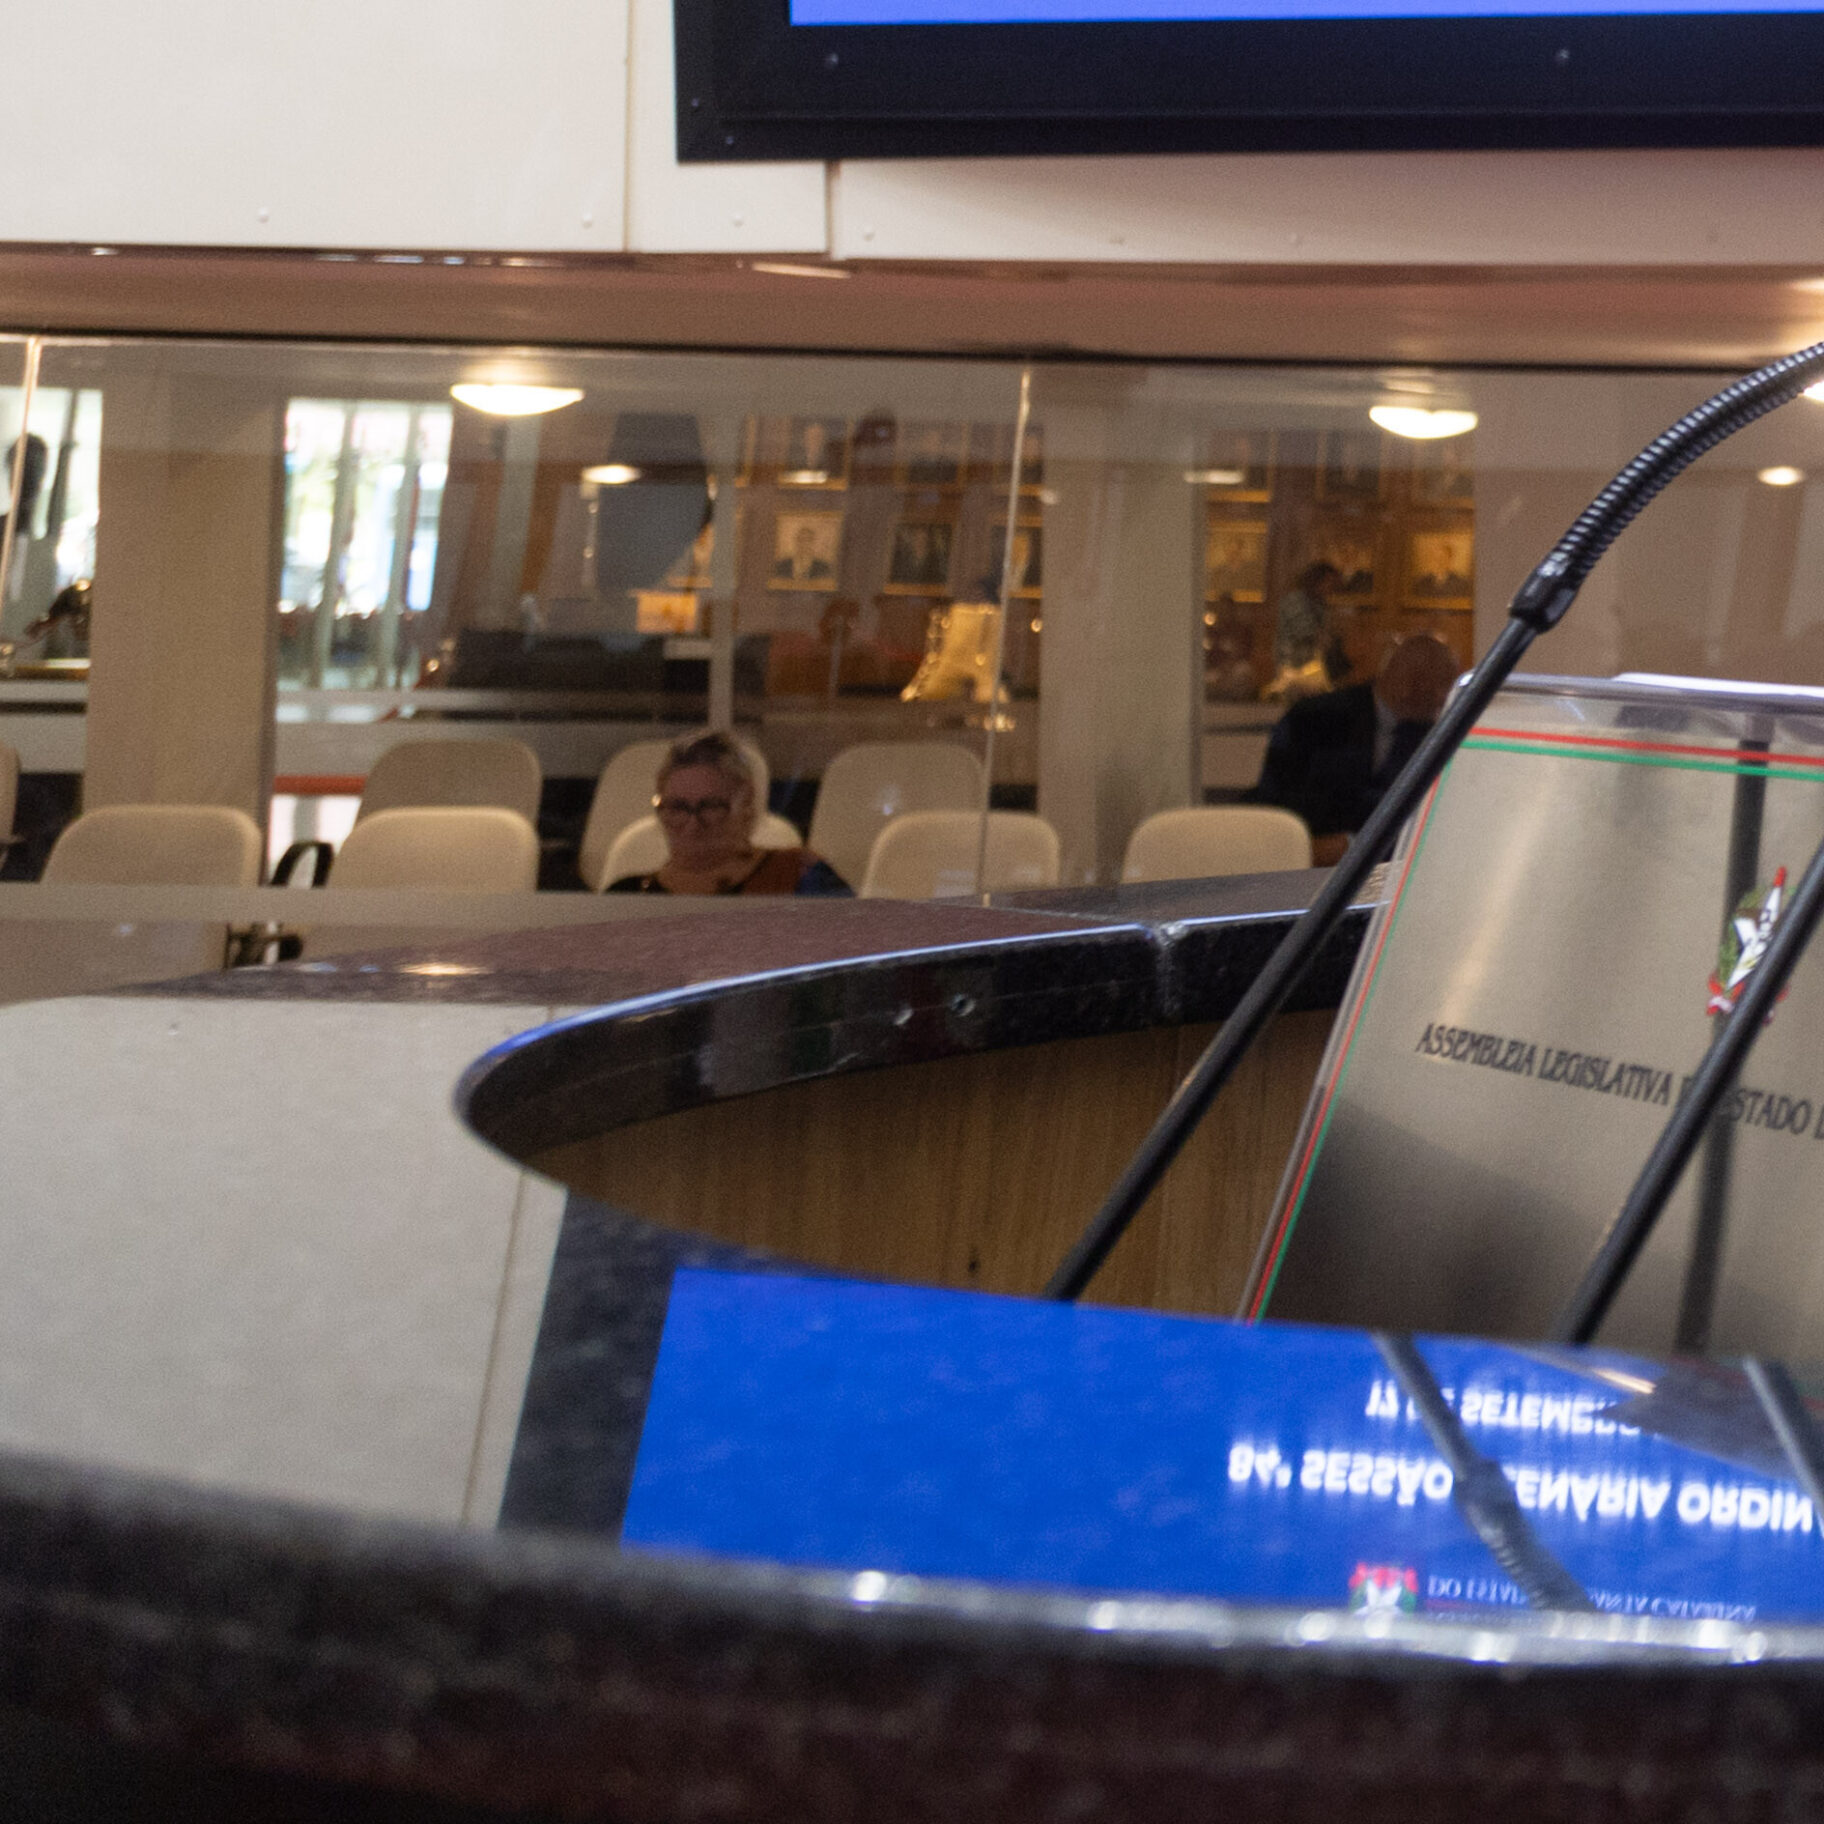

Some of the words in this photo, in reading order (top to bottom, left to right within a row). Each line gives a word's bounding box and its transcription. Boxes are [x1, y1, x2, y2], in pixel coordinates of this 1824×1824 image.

[1415, 1022, 1537, 1076] ASSEMBLEIA
[1537, 1048, 1674, 1107] LEGISLATIVA
[1722, 1087, 1811, 1135] STADO
